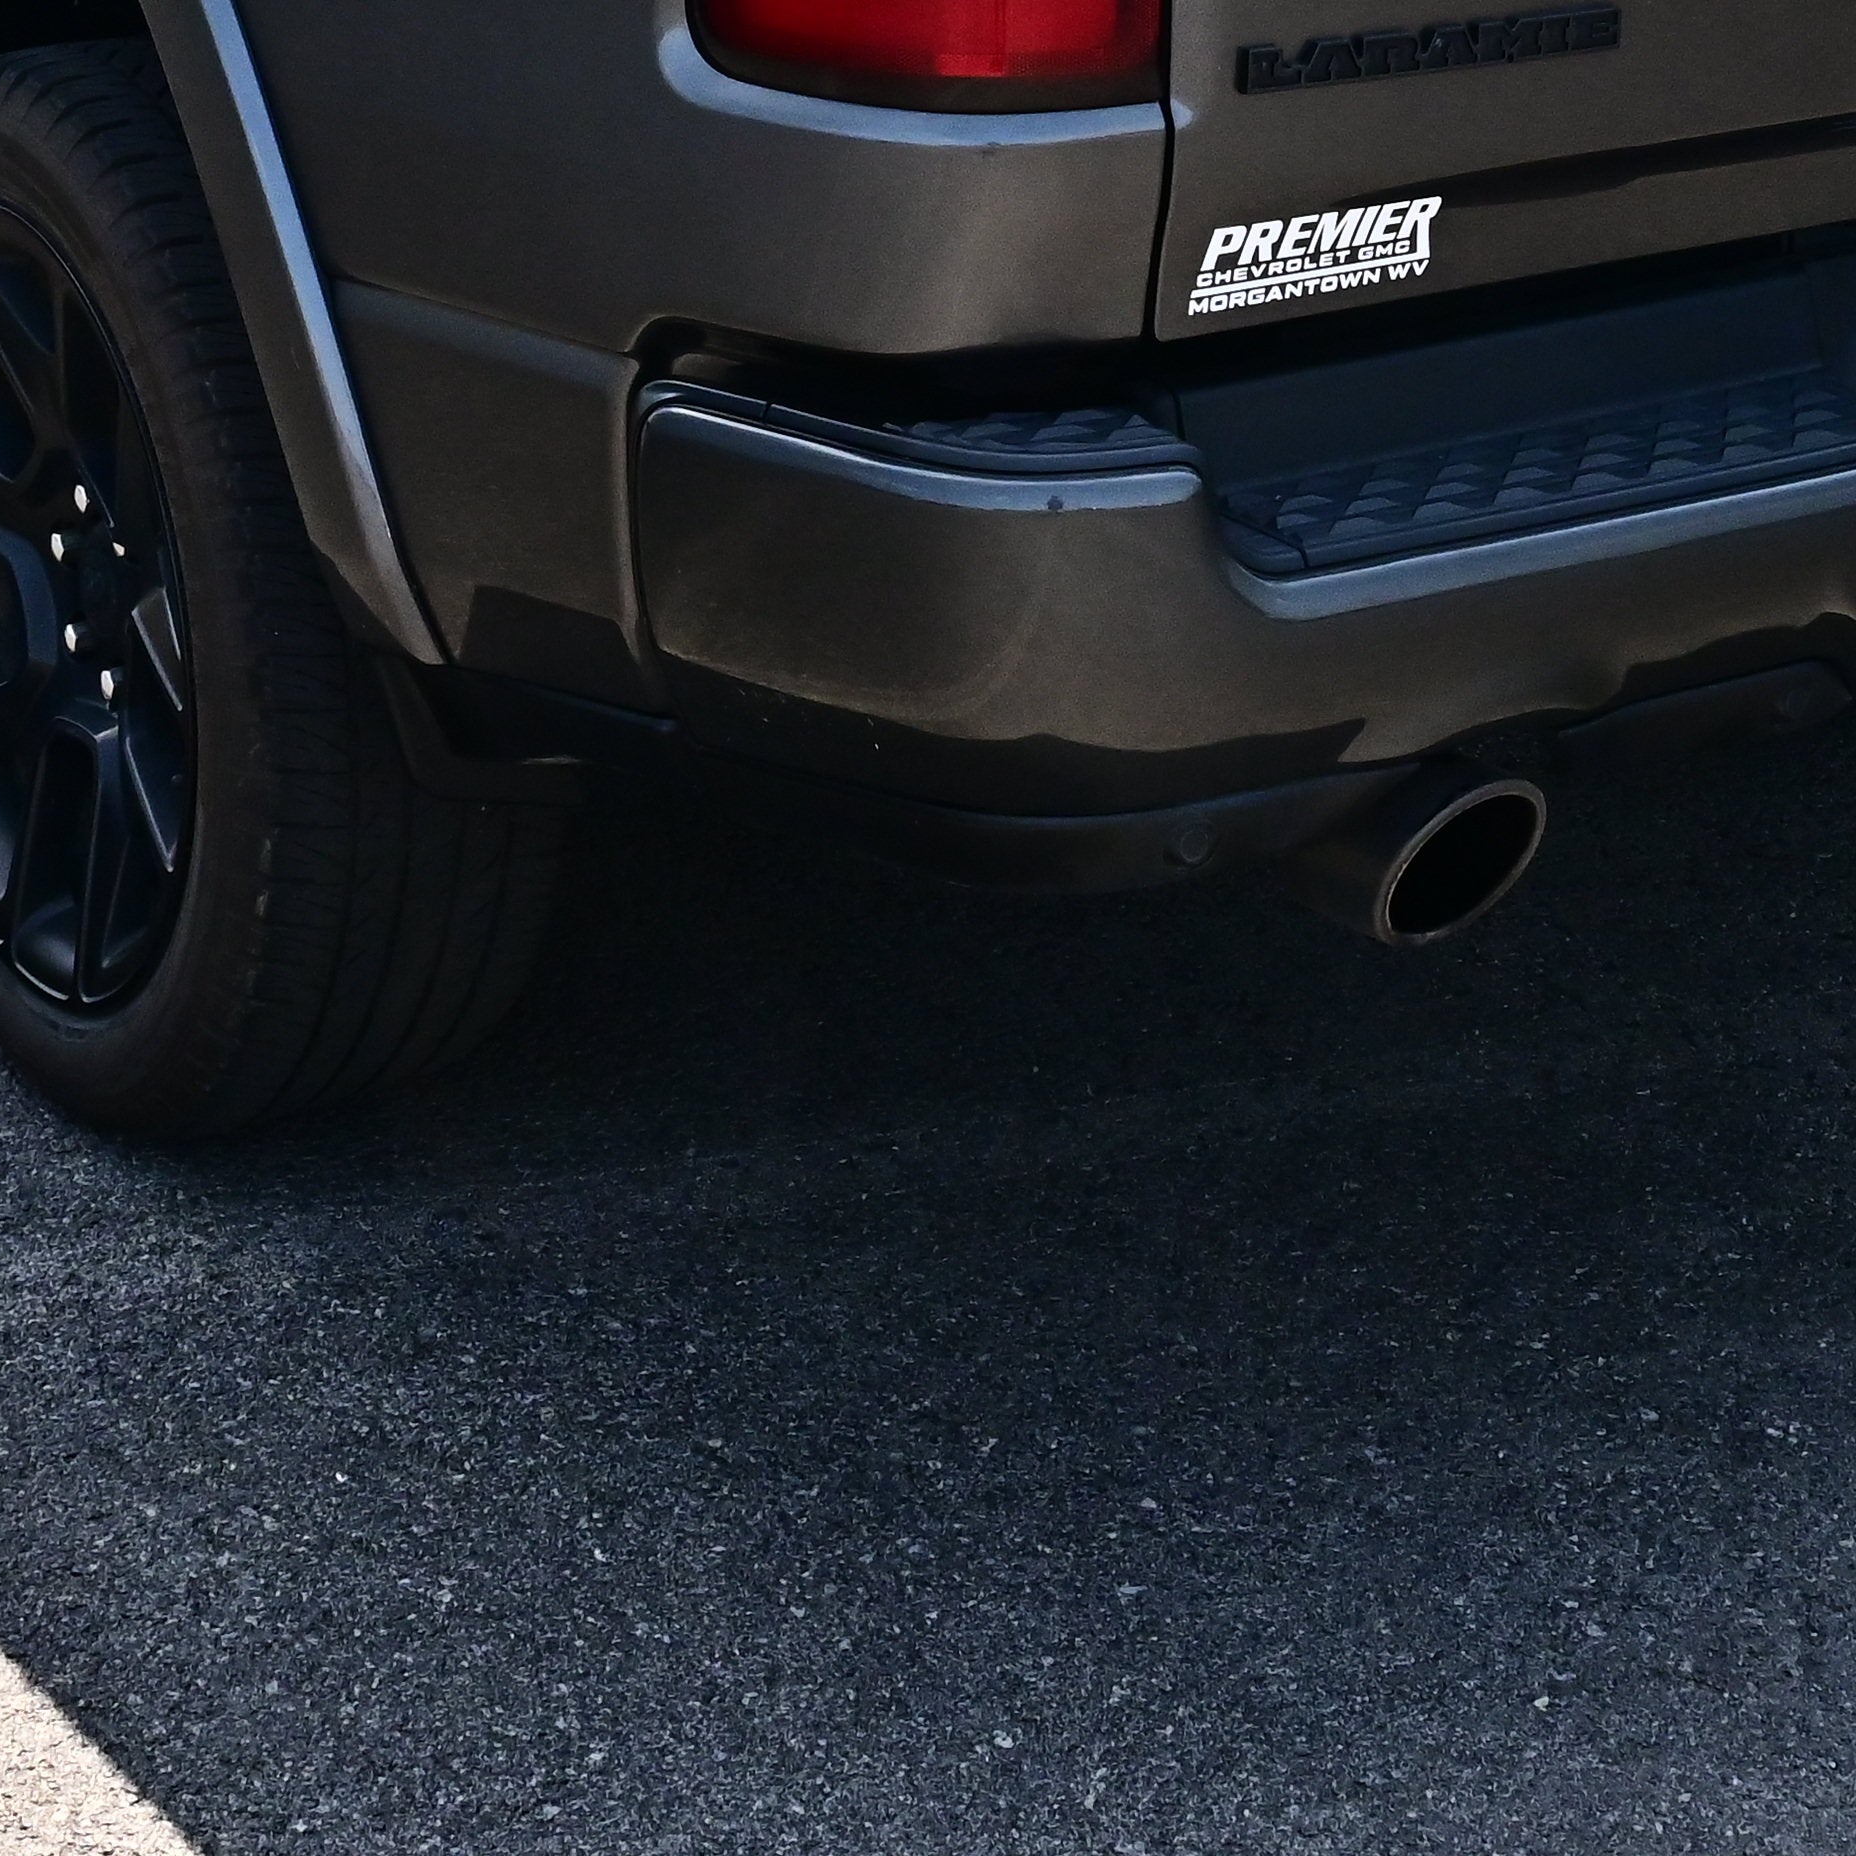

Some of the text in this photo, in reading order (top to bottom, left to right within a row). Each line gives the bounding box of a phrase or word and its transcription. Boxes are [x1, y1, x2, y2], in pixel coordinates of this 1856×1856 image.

[1237, 7, 1622, 95] LARAMIE
[1196, 240, 1410, 288] CHEVROLET GMC
[1200, 196, 1442, 272] PREMIER
[1188, 259, 1430, 316] MORGANTOWN WV
